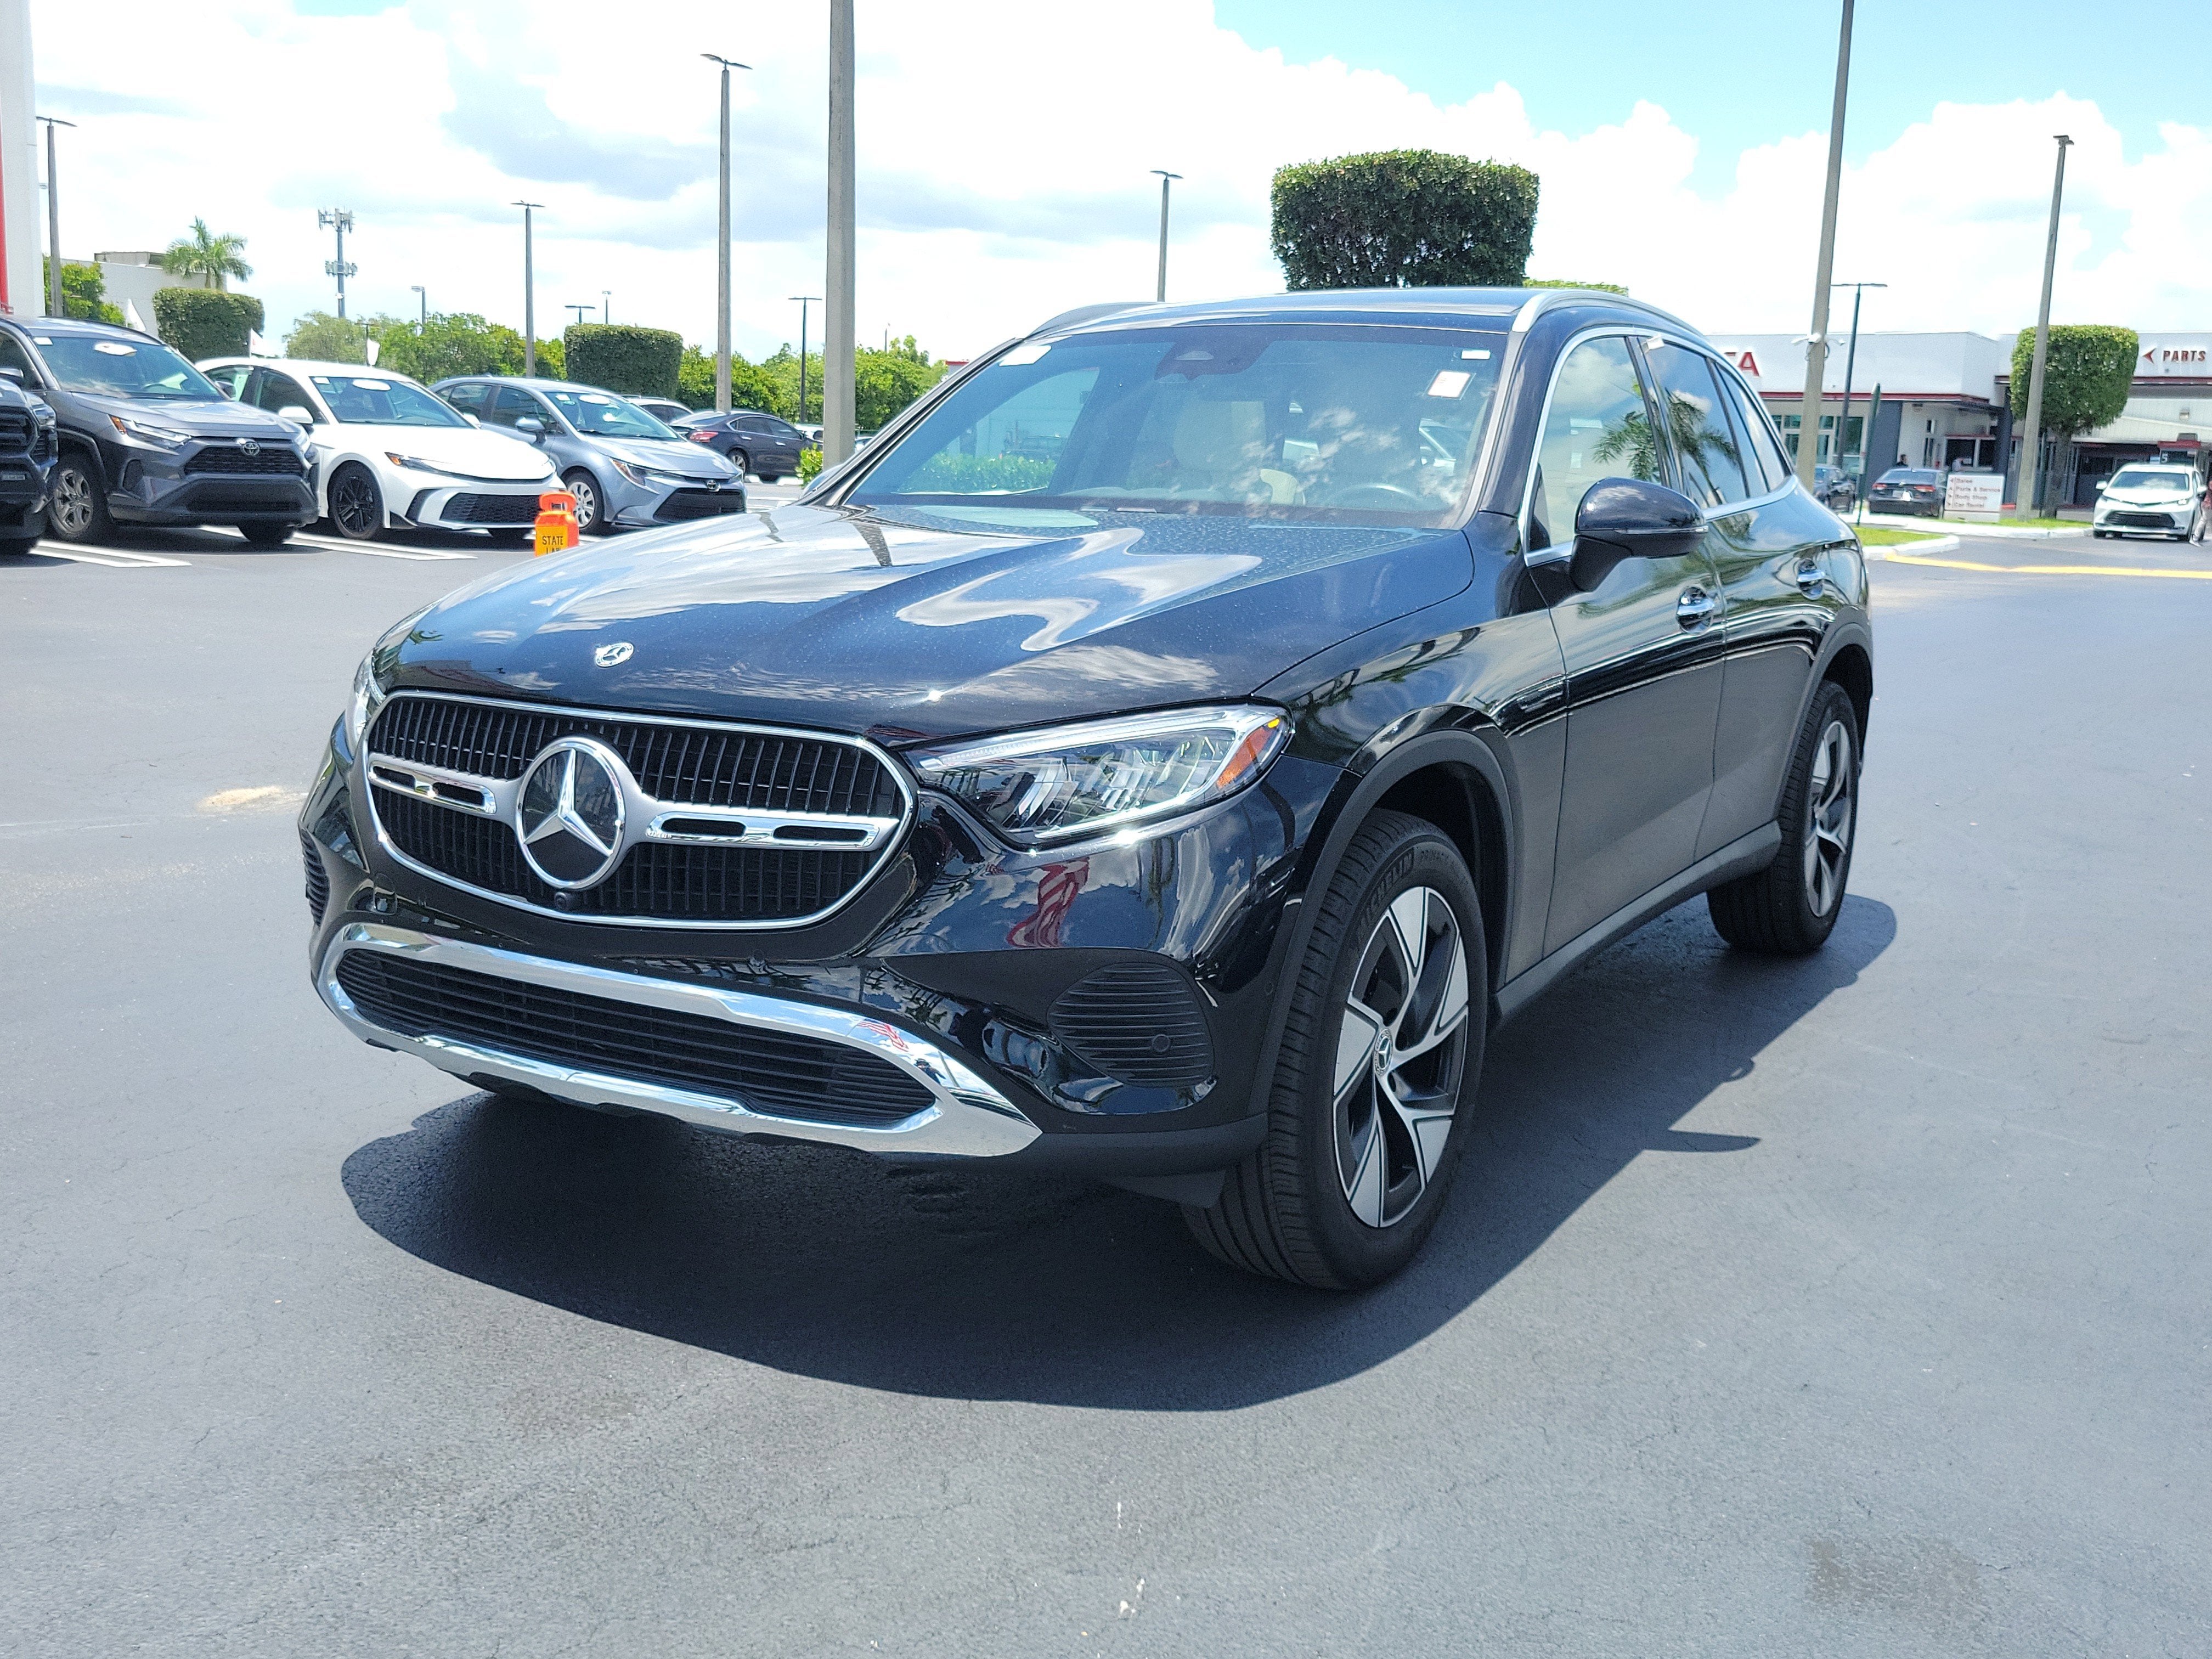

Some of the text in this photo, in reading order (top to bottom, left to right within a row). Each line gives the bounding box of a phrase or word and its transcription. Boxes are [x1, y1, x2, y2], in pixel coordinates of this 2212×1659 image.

[2163, 351, 2206, 362] PARTS
[542, 535, 563, 545] STATE
[1357, 851, 1414, 942] MICHELIN
